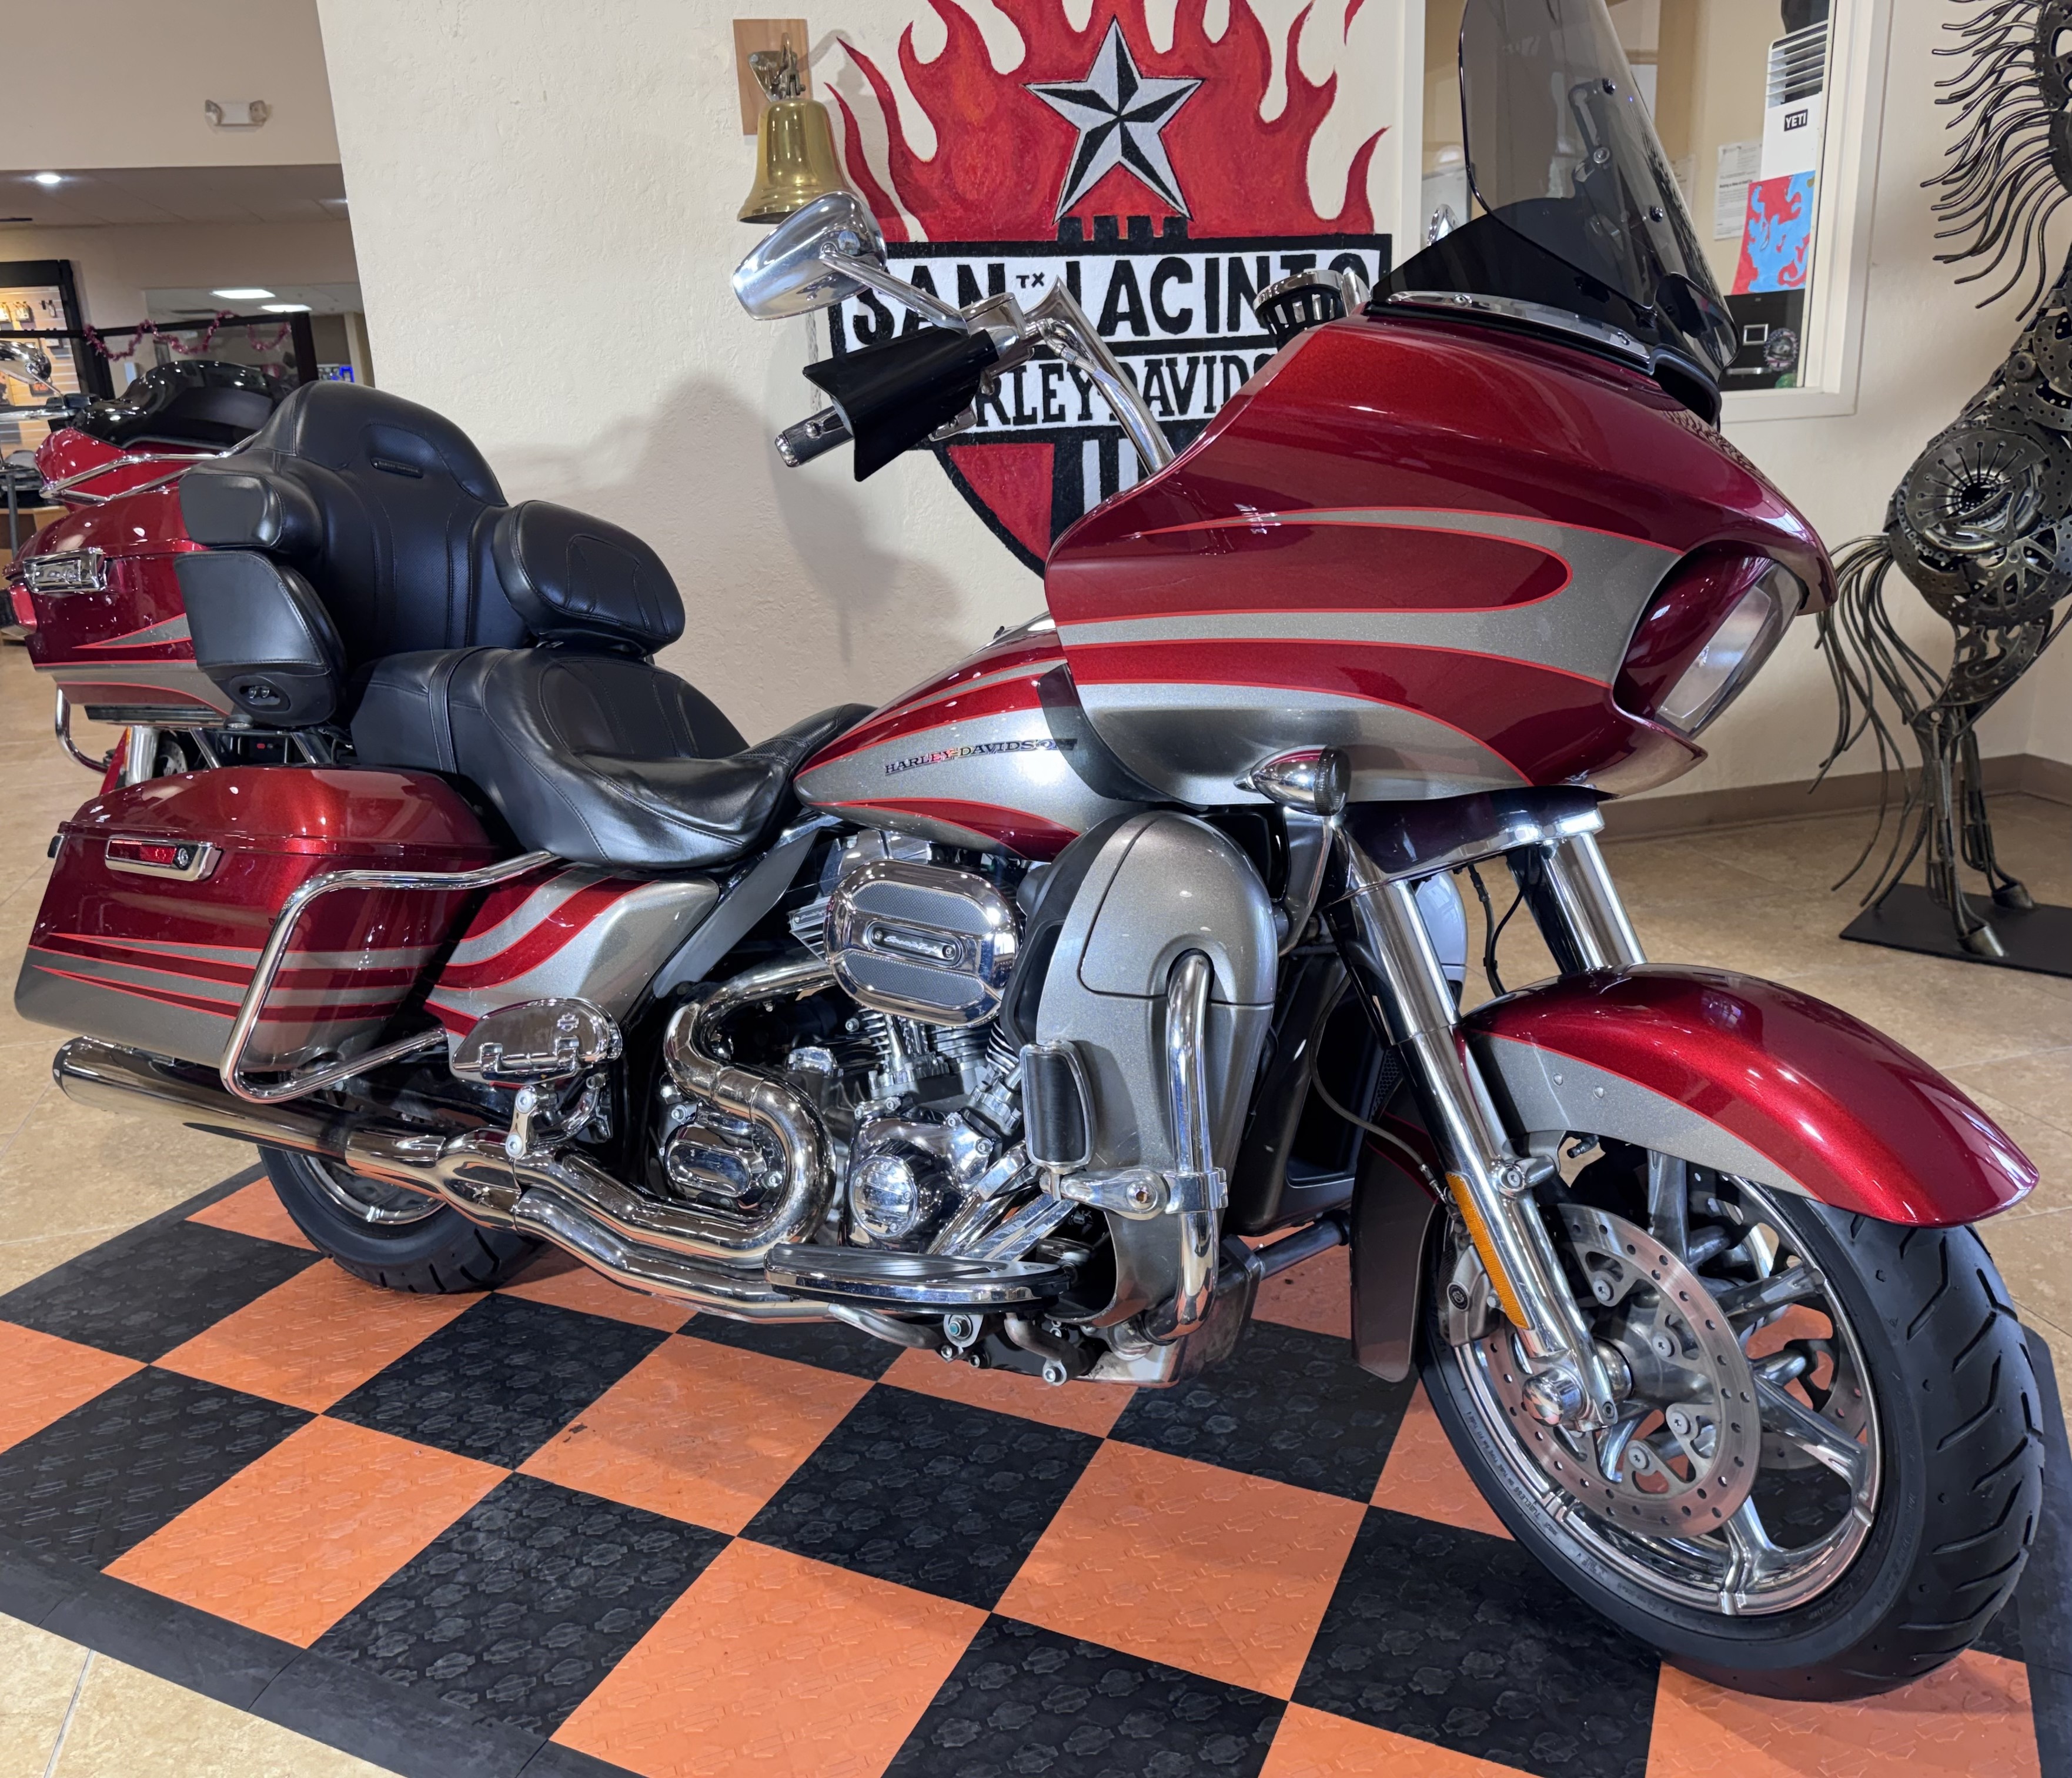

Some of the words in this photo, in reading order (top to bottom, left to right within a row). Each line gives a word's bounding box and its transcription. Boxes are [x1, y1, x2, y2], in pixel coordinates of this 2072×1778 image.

[1785, 112, 1807, 129] YETI
[1016, 272, 1045, 289] TX
[1514, 1486, 1540, 1518] TUBELESS
